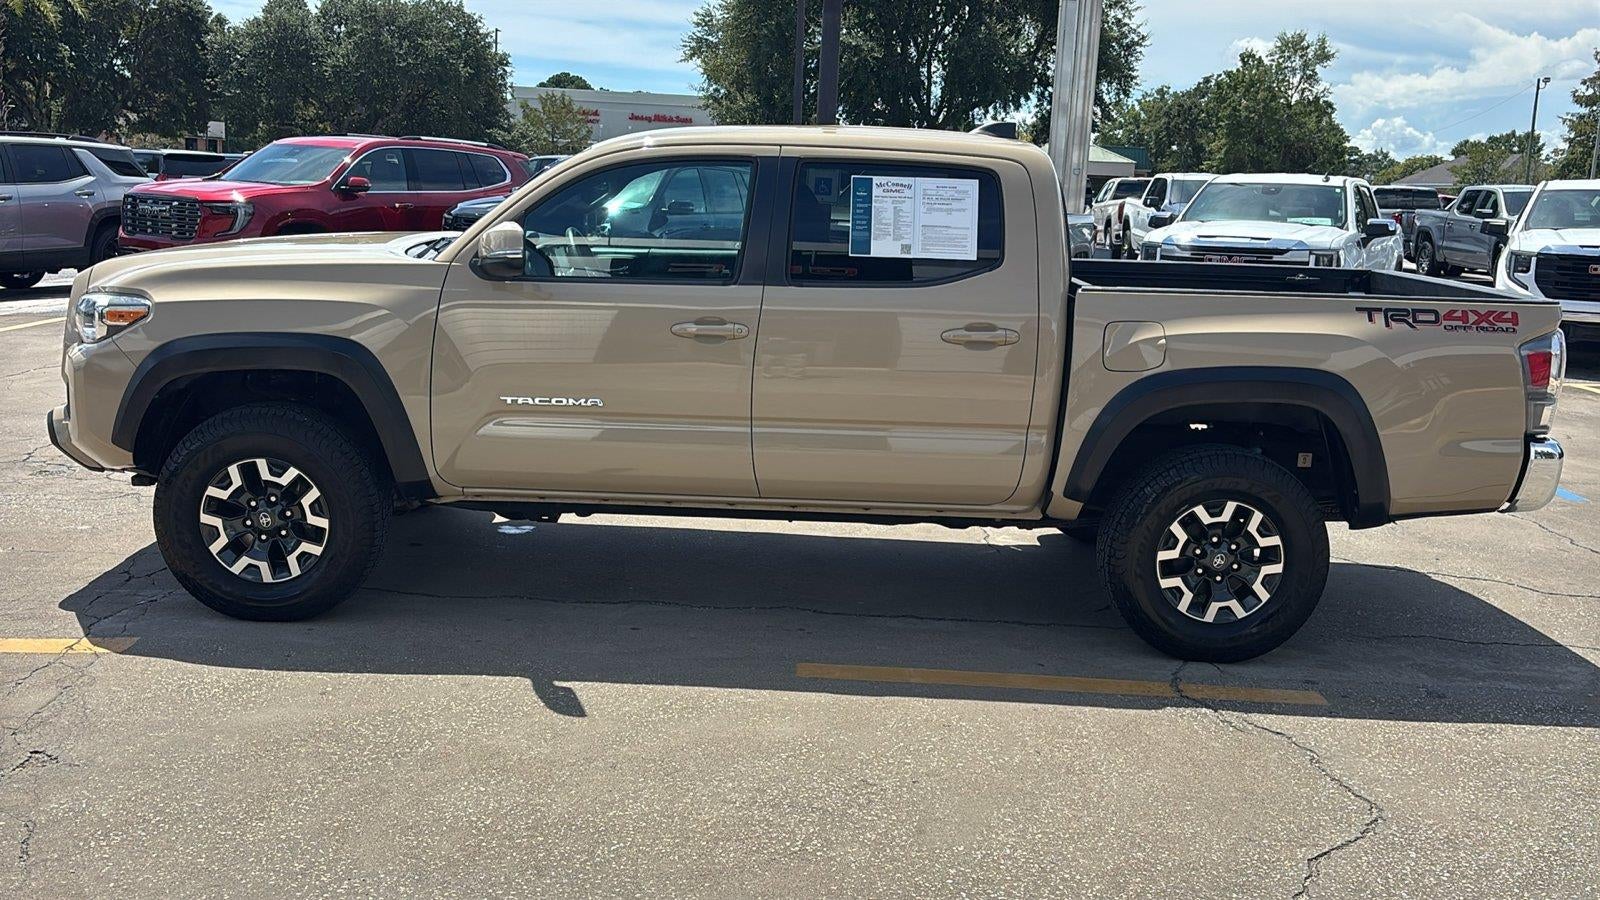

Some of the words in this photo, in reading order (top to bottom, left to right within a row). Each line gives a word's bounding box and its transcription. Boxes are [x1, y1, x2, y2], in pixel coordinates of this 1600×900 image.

[875, 181, 913, 190] McConnell
[1355, 306, 1442, 331] TRD
[1443, 325, 1473, 334] OFF
[1475, 326, 1518, 335] ROAD
[499, 396, 604, 407] TACOMA
